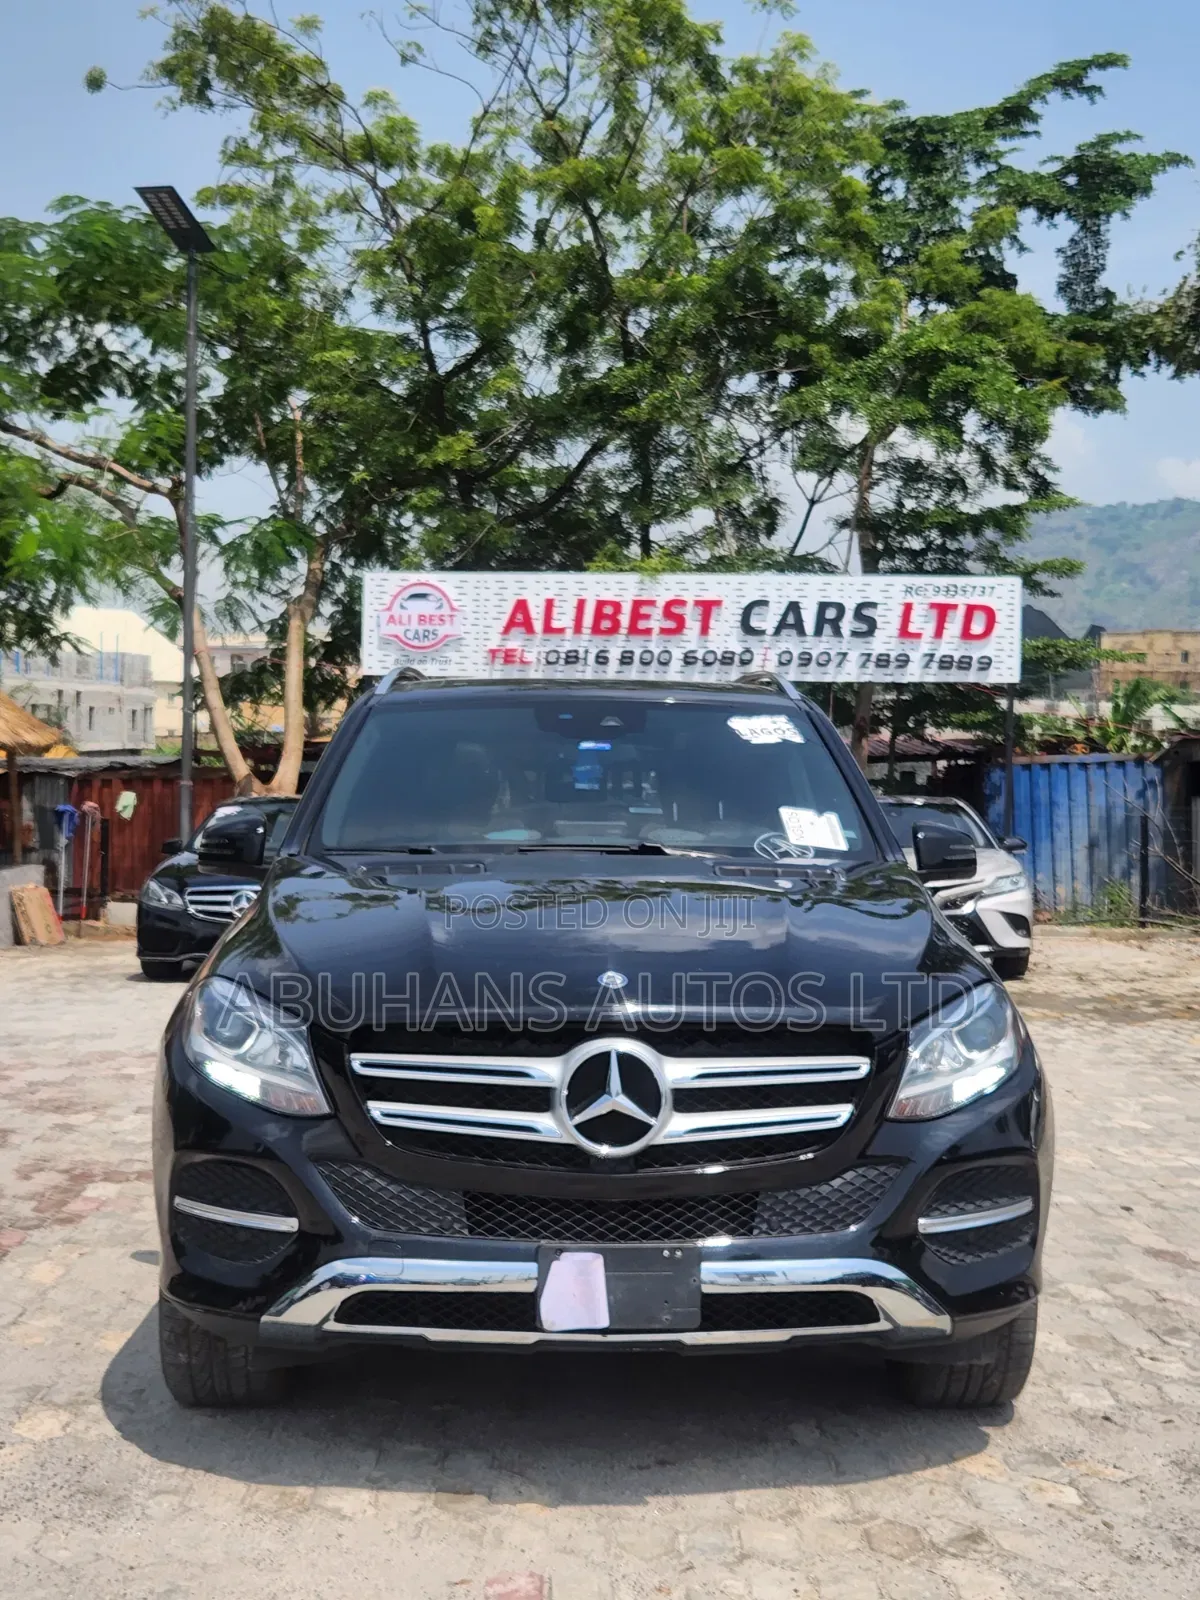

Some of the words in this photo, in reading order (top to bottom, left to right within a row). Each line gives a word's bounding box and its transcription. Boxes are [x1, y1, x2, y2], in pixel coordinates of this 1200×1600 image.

[386, 614, 411, 626] ALI
[418, 614, 456, 626] BEST
[501, 598, 723, 637] ALIBEST
[739, 599, 878, 639] CARS
[899, 602, 996, 641] LTD
[403, 629, 439, 643] CARS
[545, 649, 610, 666] 0816
[620, 649, 673, 666] 800
[778, 650, 849, 668] 0907
[859, 652, 911, 669] 789
[922, 653, 993, 671] 7889
